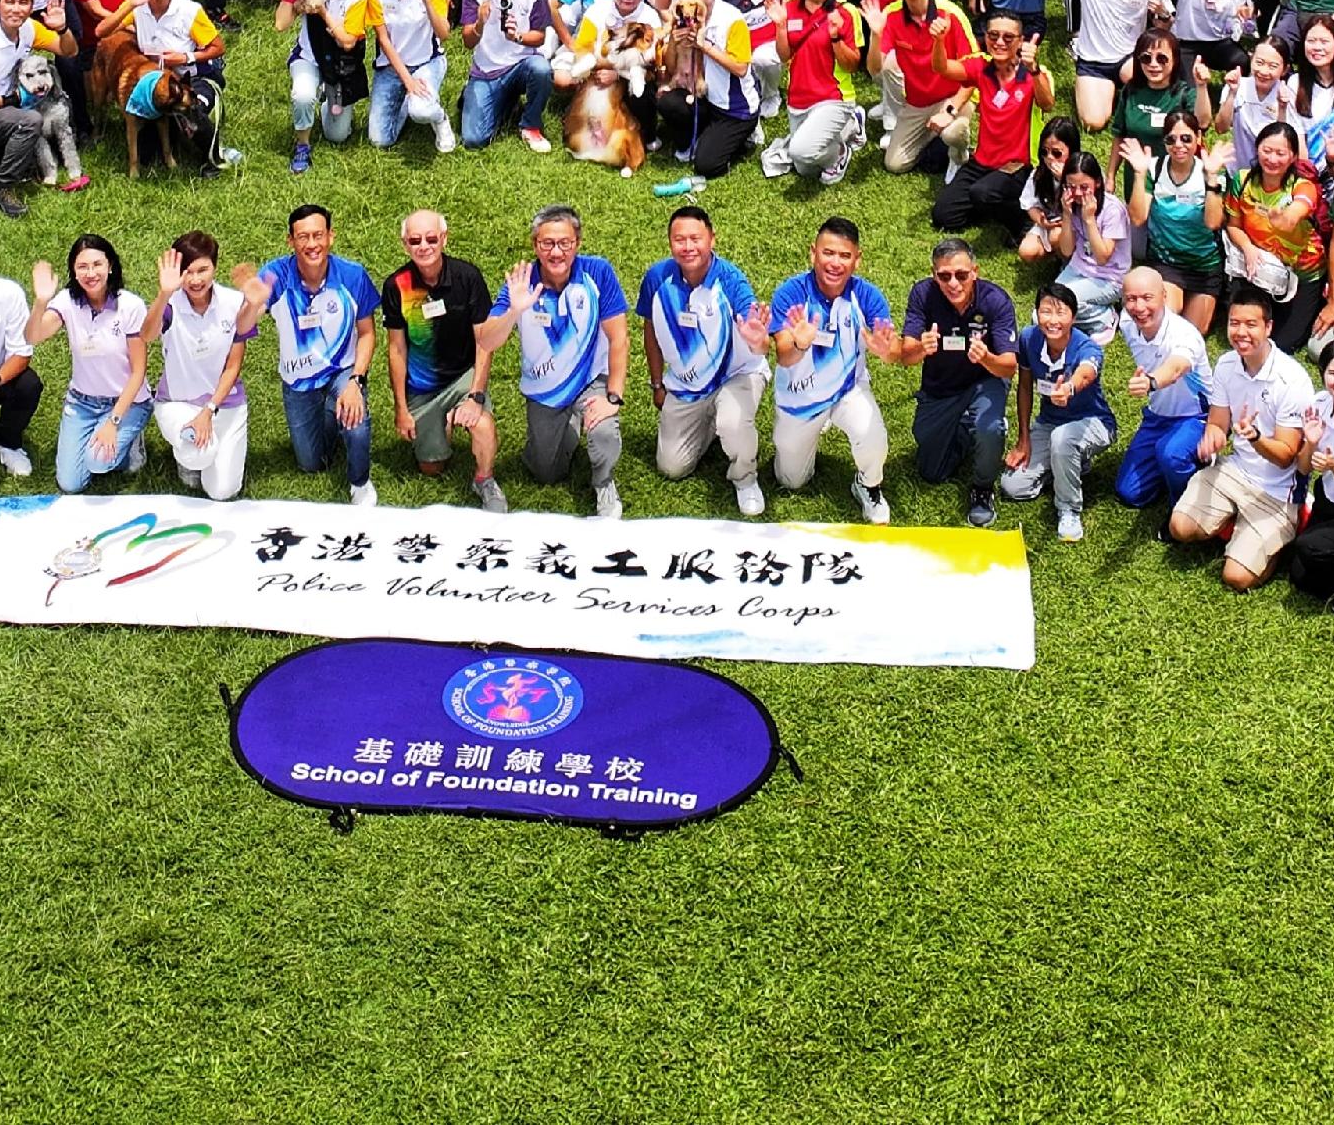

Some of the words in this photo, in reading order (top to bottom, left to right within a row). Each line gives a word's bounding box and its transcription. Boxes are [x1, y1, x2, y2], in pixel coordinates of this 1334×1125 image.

[251, 526, 864, 586] 香港警察義工服務隊
[257, 573, 367, 593] Police
[386, 576, 557, 603] Volunteer
[573, 587, 724, 617] Services
[738, 595, 841, 626] Corps
[474, 722, 549, 737] FOUNDATION
[353, 737, 645, 782] 基礎訓練學校
[290, 762, 386, 785] School
[391, 770, 423, 787] of
[426, 771, 580, 798] Foundation
[587, 783, 698, 810] Training
